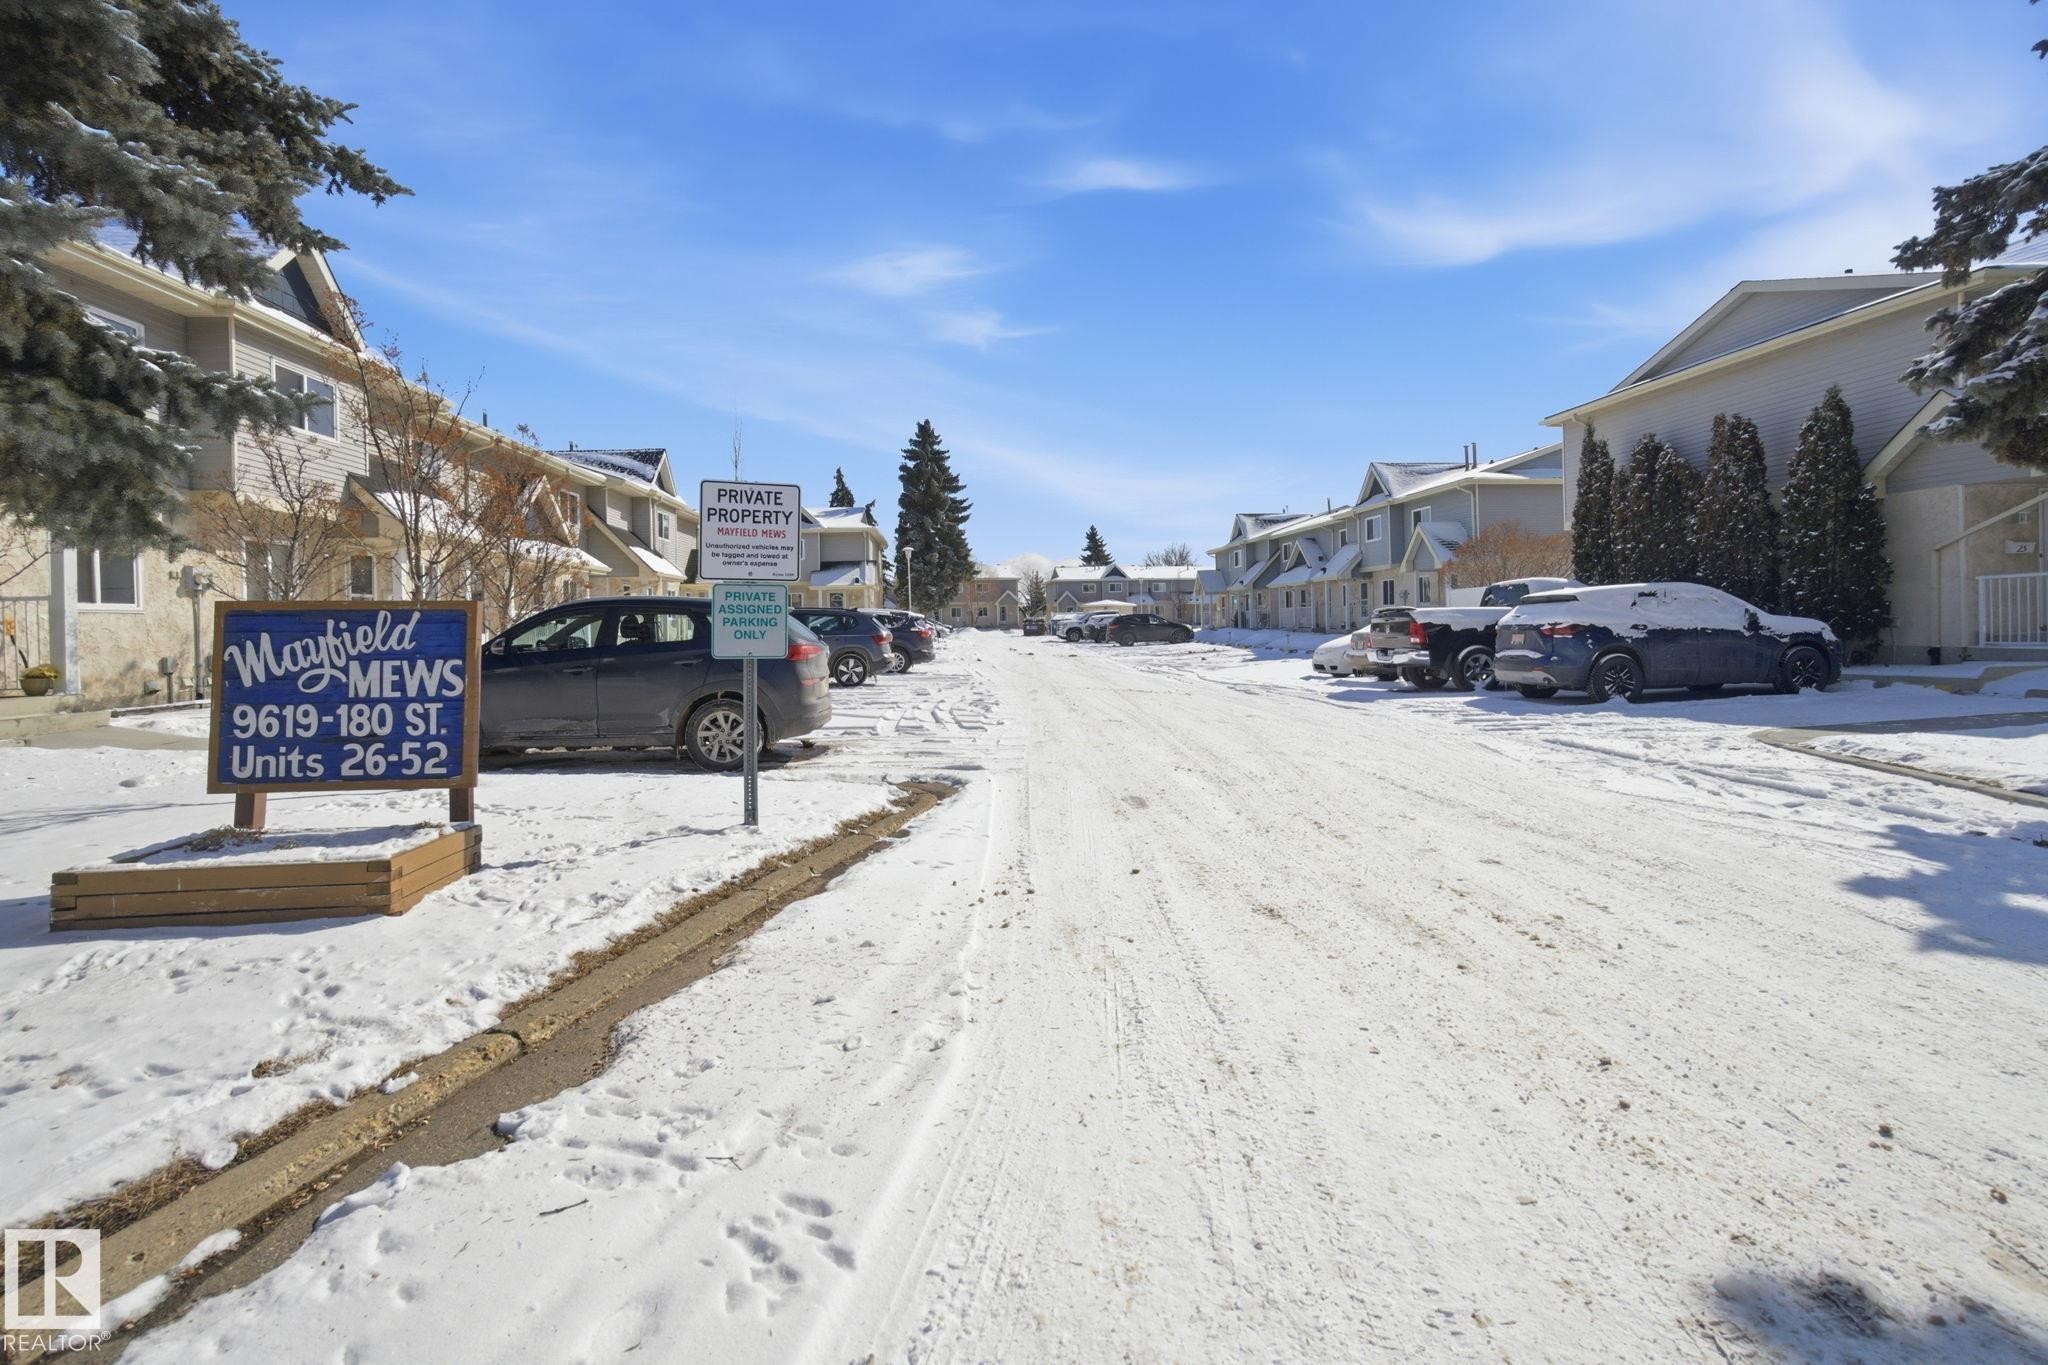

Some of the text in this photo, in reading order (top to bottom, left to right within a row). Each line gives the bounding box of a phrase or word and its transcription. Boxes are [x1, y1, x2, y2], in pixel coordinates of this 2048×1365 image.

[717, 488, 783, 506] PRIVATE
[707, 507, 793, 525] PROPERTY
[717, 527, 786, 539] MAYFIELD MEWS
[705, 542, 750, 550] Unauthorized
[725, 591, 776, 601] PRIVATE
[718, 605, 782, 614] ASSIGNED
[722, 617, 778, 627] PARKING
[734, 630, 767, 640] ONLY
[223, 610, 421, 693] Mayfield
[348, 659, 465, 698] MEWS
[232, 702, 448, 739] 9619-180 ST.
[231, 741, 448, 779] Units 26-52
